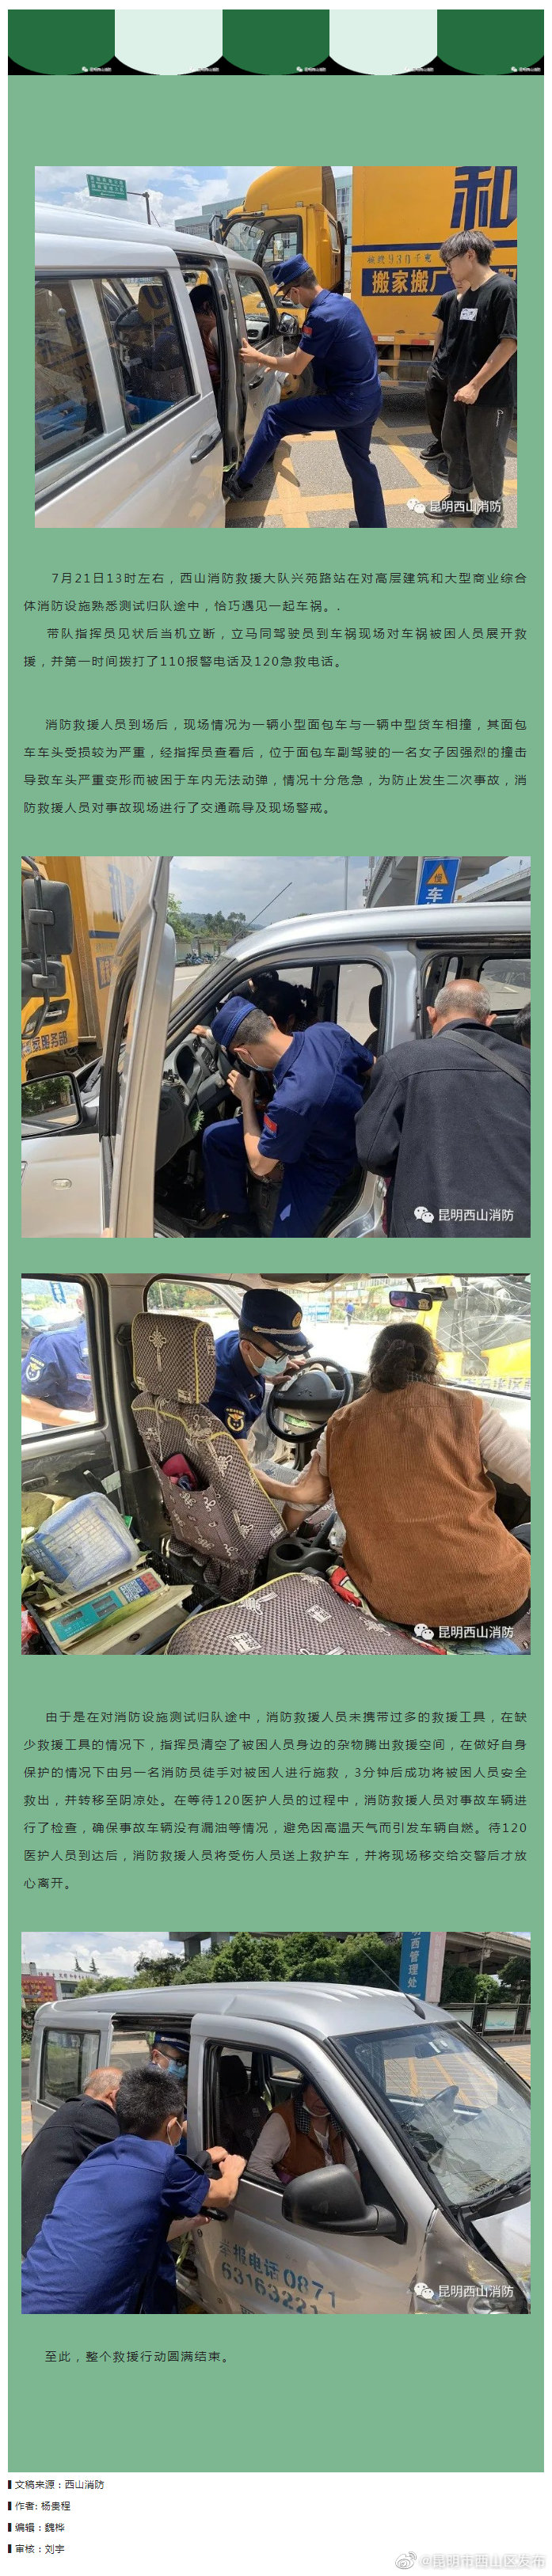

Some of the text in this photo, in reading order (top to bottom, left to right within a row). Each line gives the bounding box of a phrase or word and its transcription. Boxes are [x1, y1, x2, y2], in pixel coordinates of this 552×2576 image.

[451, 166, 517, 231] 和
[372, 269, 450, 294] 搬家搬厂
[51, 572, 527, 585] 7月21日13时左右，西山消防救援大队兴苑路站在对高层建筑和大型商业综合
[47, 627, 527, 640] 带队指挥员见状后当机立断，立马同驾驶员到车祸现场对车祸被困人员展开救
[23, 655, 341, 668] 援，并第一时间拨打了110报警电话及120急救电话。
[45, 718, 527, 731] 消防救援人员到场后，现场情况为一辆小型面包车与一辆中型货车相撞，其面包
[23, 745, 527, 759] 车车头受损较为严重，经指挥员查看后，位于面包车副驾驶的一名女子因强烈的撞击
[23, 774, 527, 787] 导致车头严重变形而被困于车内无法动弹，情况十分危急，为防止发生二次事故，消
[23, 802, 329, 814] 防救援人员对事故现场进行了交通疏导及现场警戒。
[425, 887, 444, 902] 车
[46, 1711, 527, 1724] 由于是在对消防设施测试归队途中，消防救援人员未携带过多的救援工具，在缺
[23, 1738, 527, 1751] 少救援工具的情况下，指挥员清空了被困人员身边的杂物腾出救援空间，在做好自身
[23, 1766, 527, 1779] 保护的情况下由另一名消防员徒手对被困人进行施救，3分钟后成功将被困人员安全
[23, 1794, 527, 1807] 救出，并转移至阴凉处。在等待120医护人员的过程中，消防救援人员对事故车辆进
[23, 1822, 527, 1834] 行了检查，确保事故车辆没有漏油等情况，避免因高温天气而引发车辆自燃。待120
[24, 1849, 527, 1862] 医护人员到达后，消防救援人员将受伤人员送上救护车，并将现场移交给交警后才放
[24, 1877, 70, 1890] 心离开。
[219, 2238, 336, 2309] 举报电话 0871
[221, 2261, 318, 2314] 63163221
[44, 2350, 228, 2363] 至此，整个救援行动圆满结束。
[14, 2479, 105, 2490] 文稿来源：西山消防
[40, 2501, 71, 2511] 杨贵程
[14, 2522, 65, 2533] 编辑：魏桦
[14, 2544, 65, 2555] 审核：刘宇
